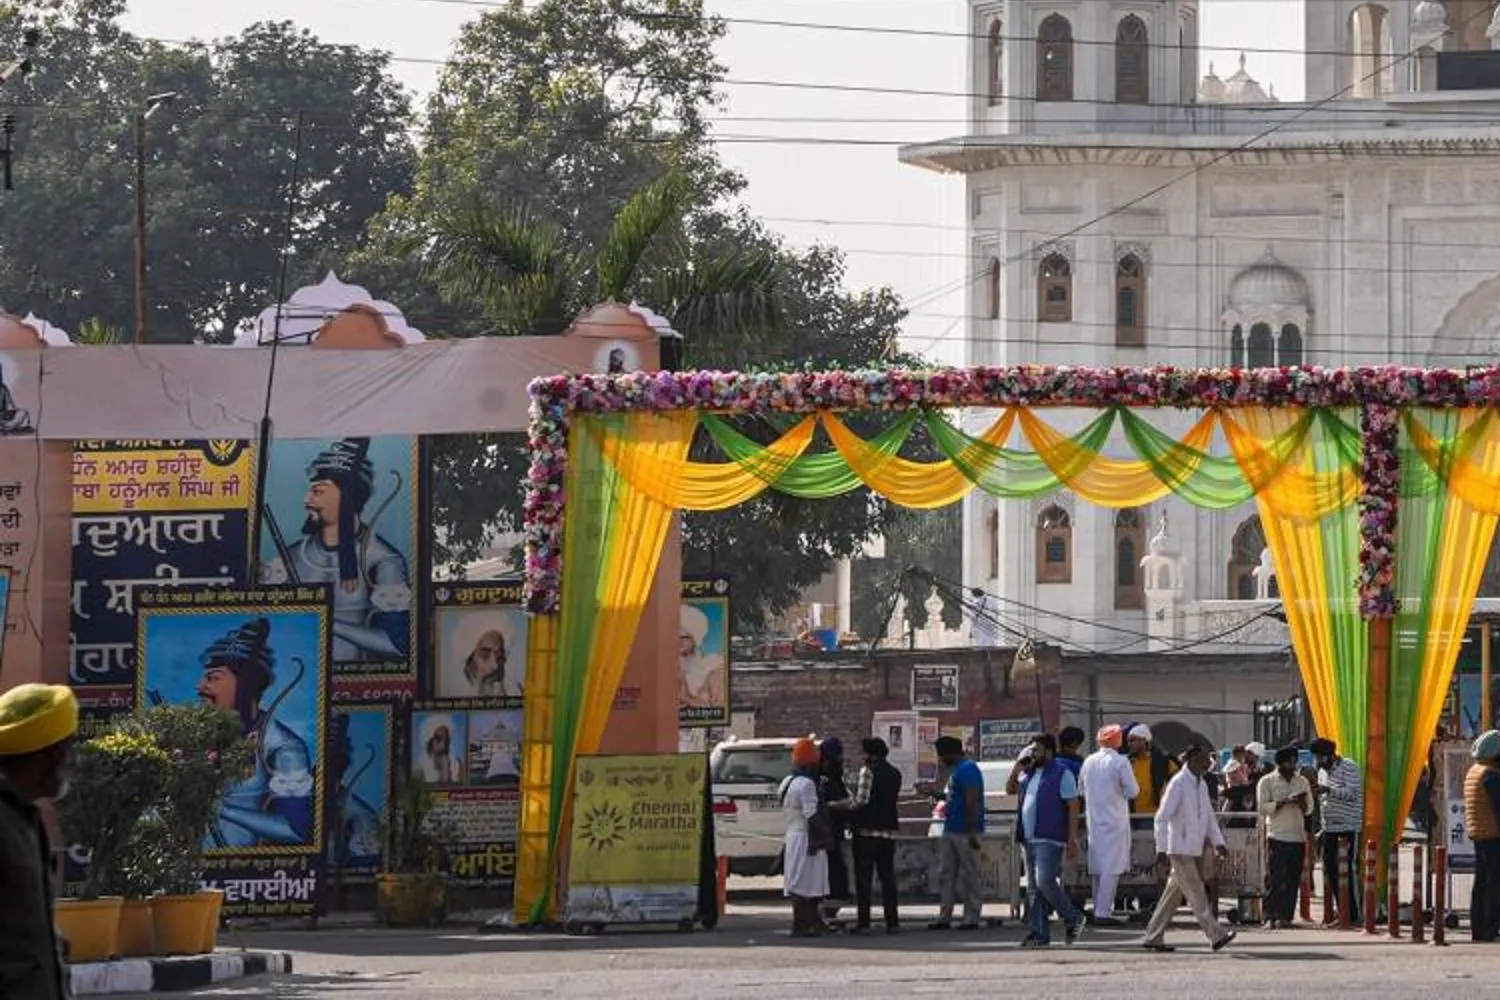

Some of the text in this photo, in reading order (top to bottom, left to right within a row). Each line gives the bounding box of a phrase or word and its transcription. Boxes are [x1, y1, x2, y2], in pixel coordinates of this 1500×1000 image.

[73, 483, 100, 499] ਾਬਾ
[179, 475, 213, 498] ਸਿੰਘ
[221, 474, 240, 497] ਜੀ
[224, 870, 317, 901] ਵਧਾਈਆਂ
